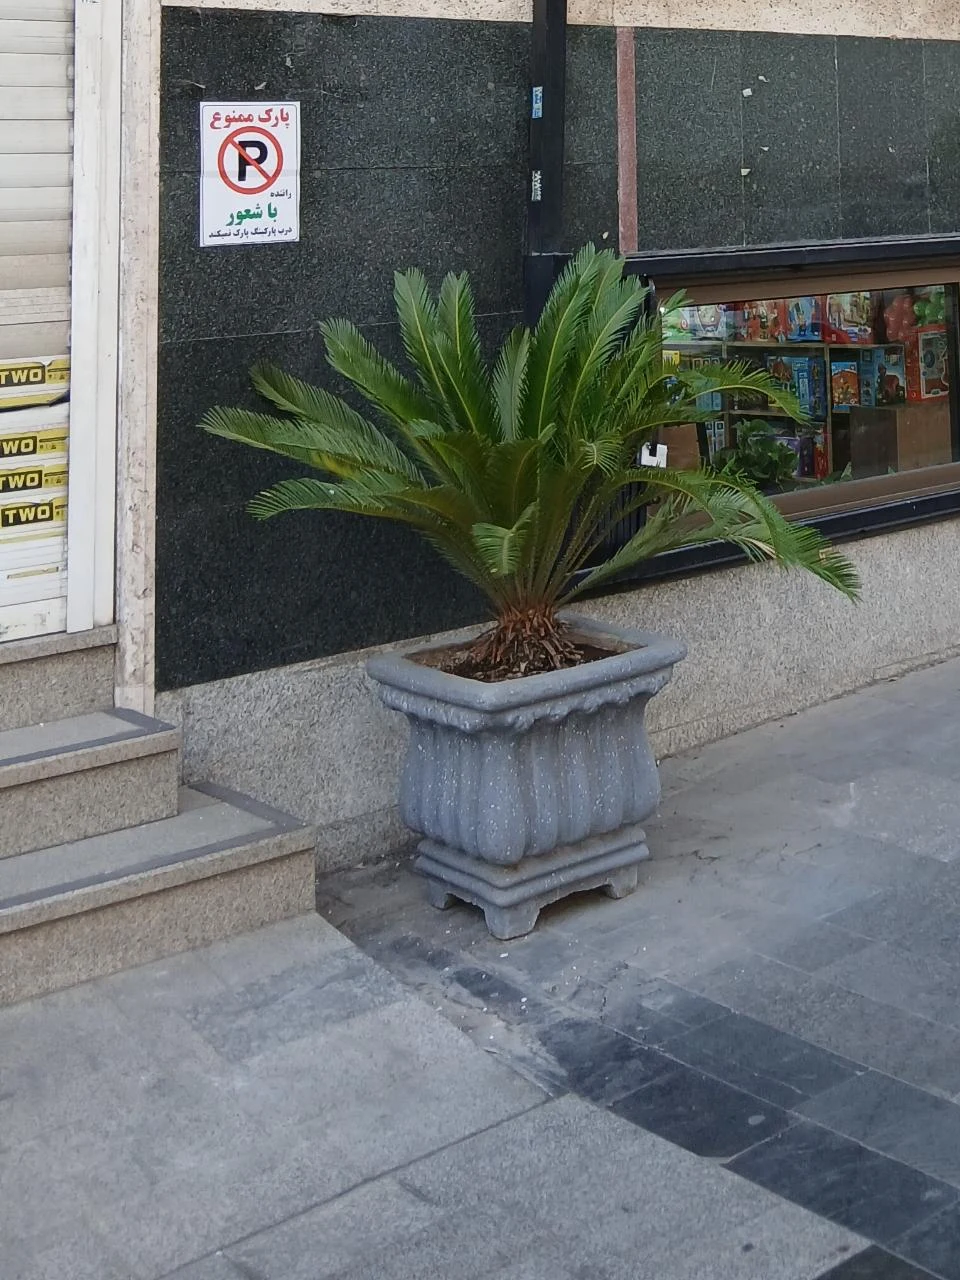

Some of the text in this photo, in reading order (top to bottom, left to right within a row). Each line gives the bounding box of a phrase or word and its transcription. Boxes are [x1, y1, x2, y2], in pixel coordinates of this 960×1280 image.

[209, 107, 290, 130] پارک ممنوع
[269, 189, 292, 199] راننده
[226, 202, 278, 226] با شعور
[0, 439, 34, 455] WO
[4, 505, 50, 524] TWO
